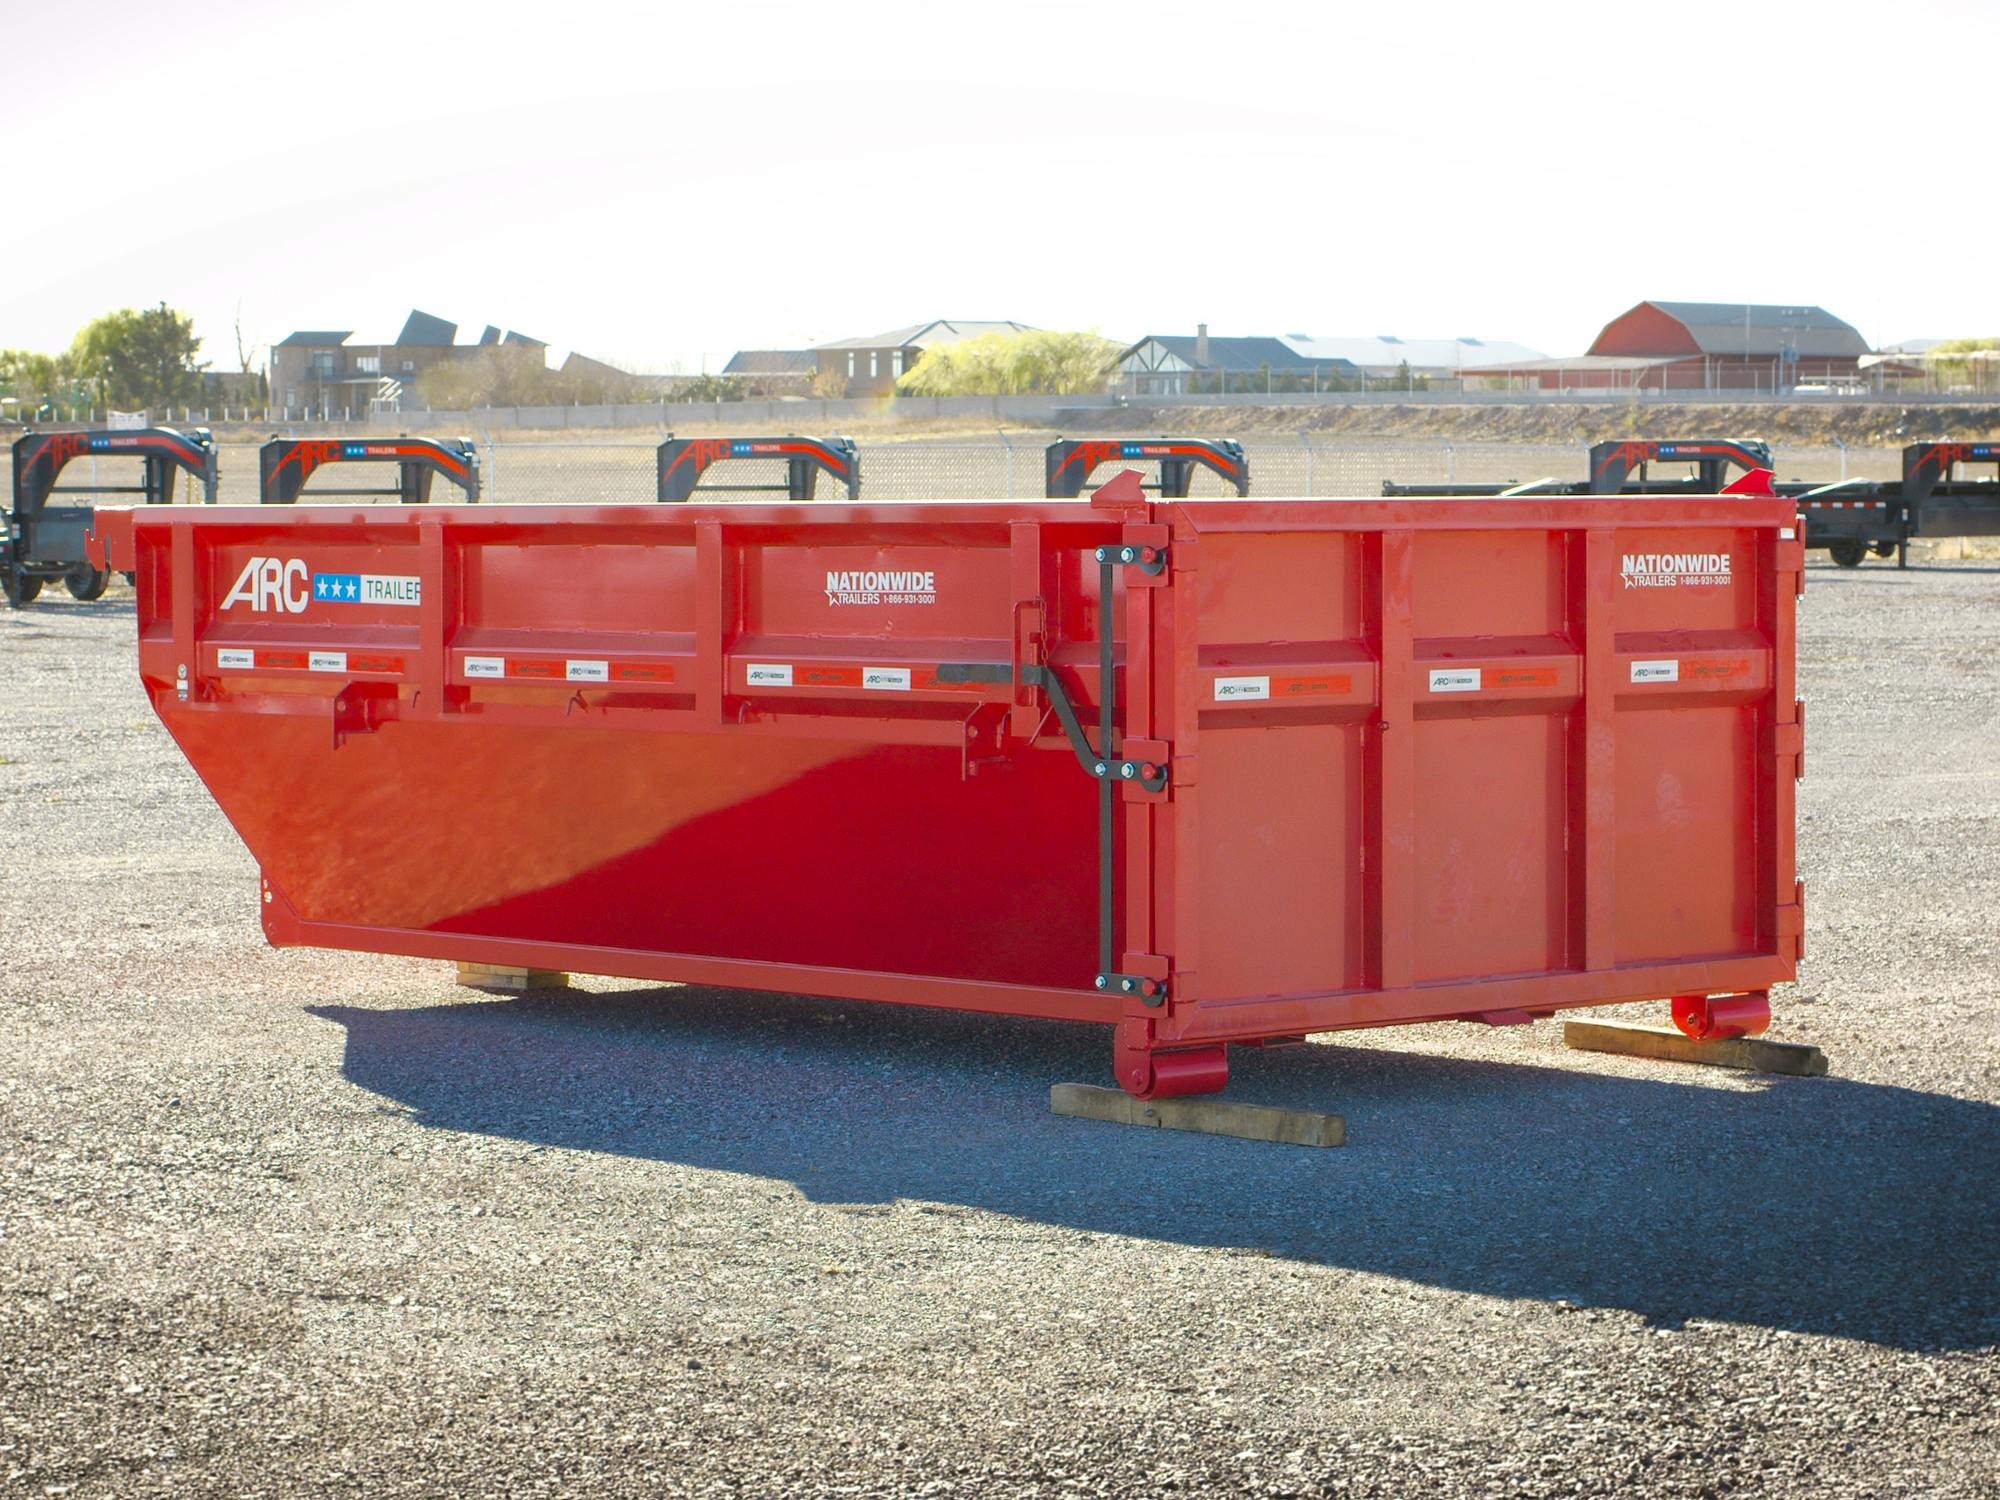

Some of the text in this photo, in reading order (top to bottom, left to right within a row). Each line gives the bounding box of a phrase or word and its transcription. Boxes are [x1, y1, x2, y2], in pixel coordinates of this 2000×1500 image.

[20, 434, 89, 481] ARC
[266, 440, 397, 486] ARC TRAILERS
[663, 439, 780, 484] ARC TRAILERS
[1053, 441, 1121, 485] ARC
[1596, 442, 1658, 478] ARC
[1908, 443, 1971, 478] ARC
[1622, 554, 1730, 573] NATIONWIDE
[220, 557, 309, 614] ARC
[826, 571, 934, 591] NATIONWIDE
[1633, 575, 1731, 587] TRAILERS 1-866-931-3001
[838, 593, 936, 605] TRAILERS 1-866-931-3001
[866, 675, 881, 684] ARC
[1218, 686, 1235, 695] ARC
[1433, 677, 1449, 686] ARC
